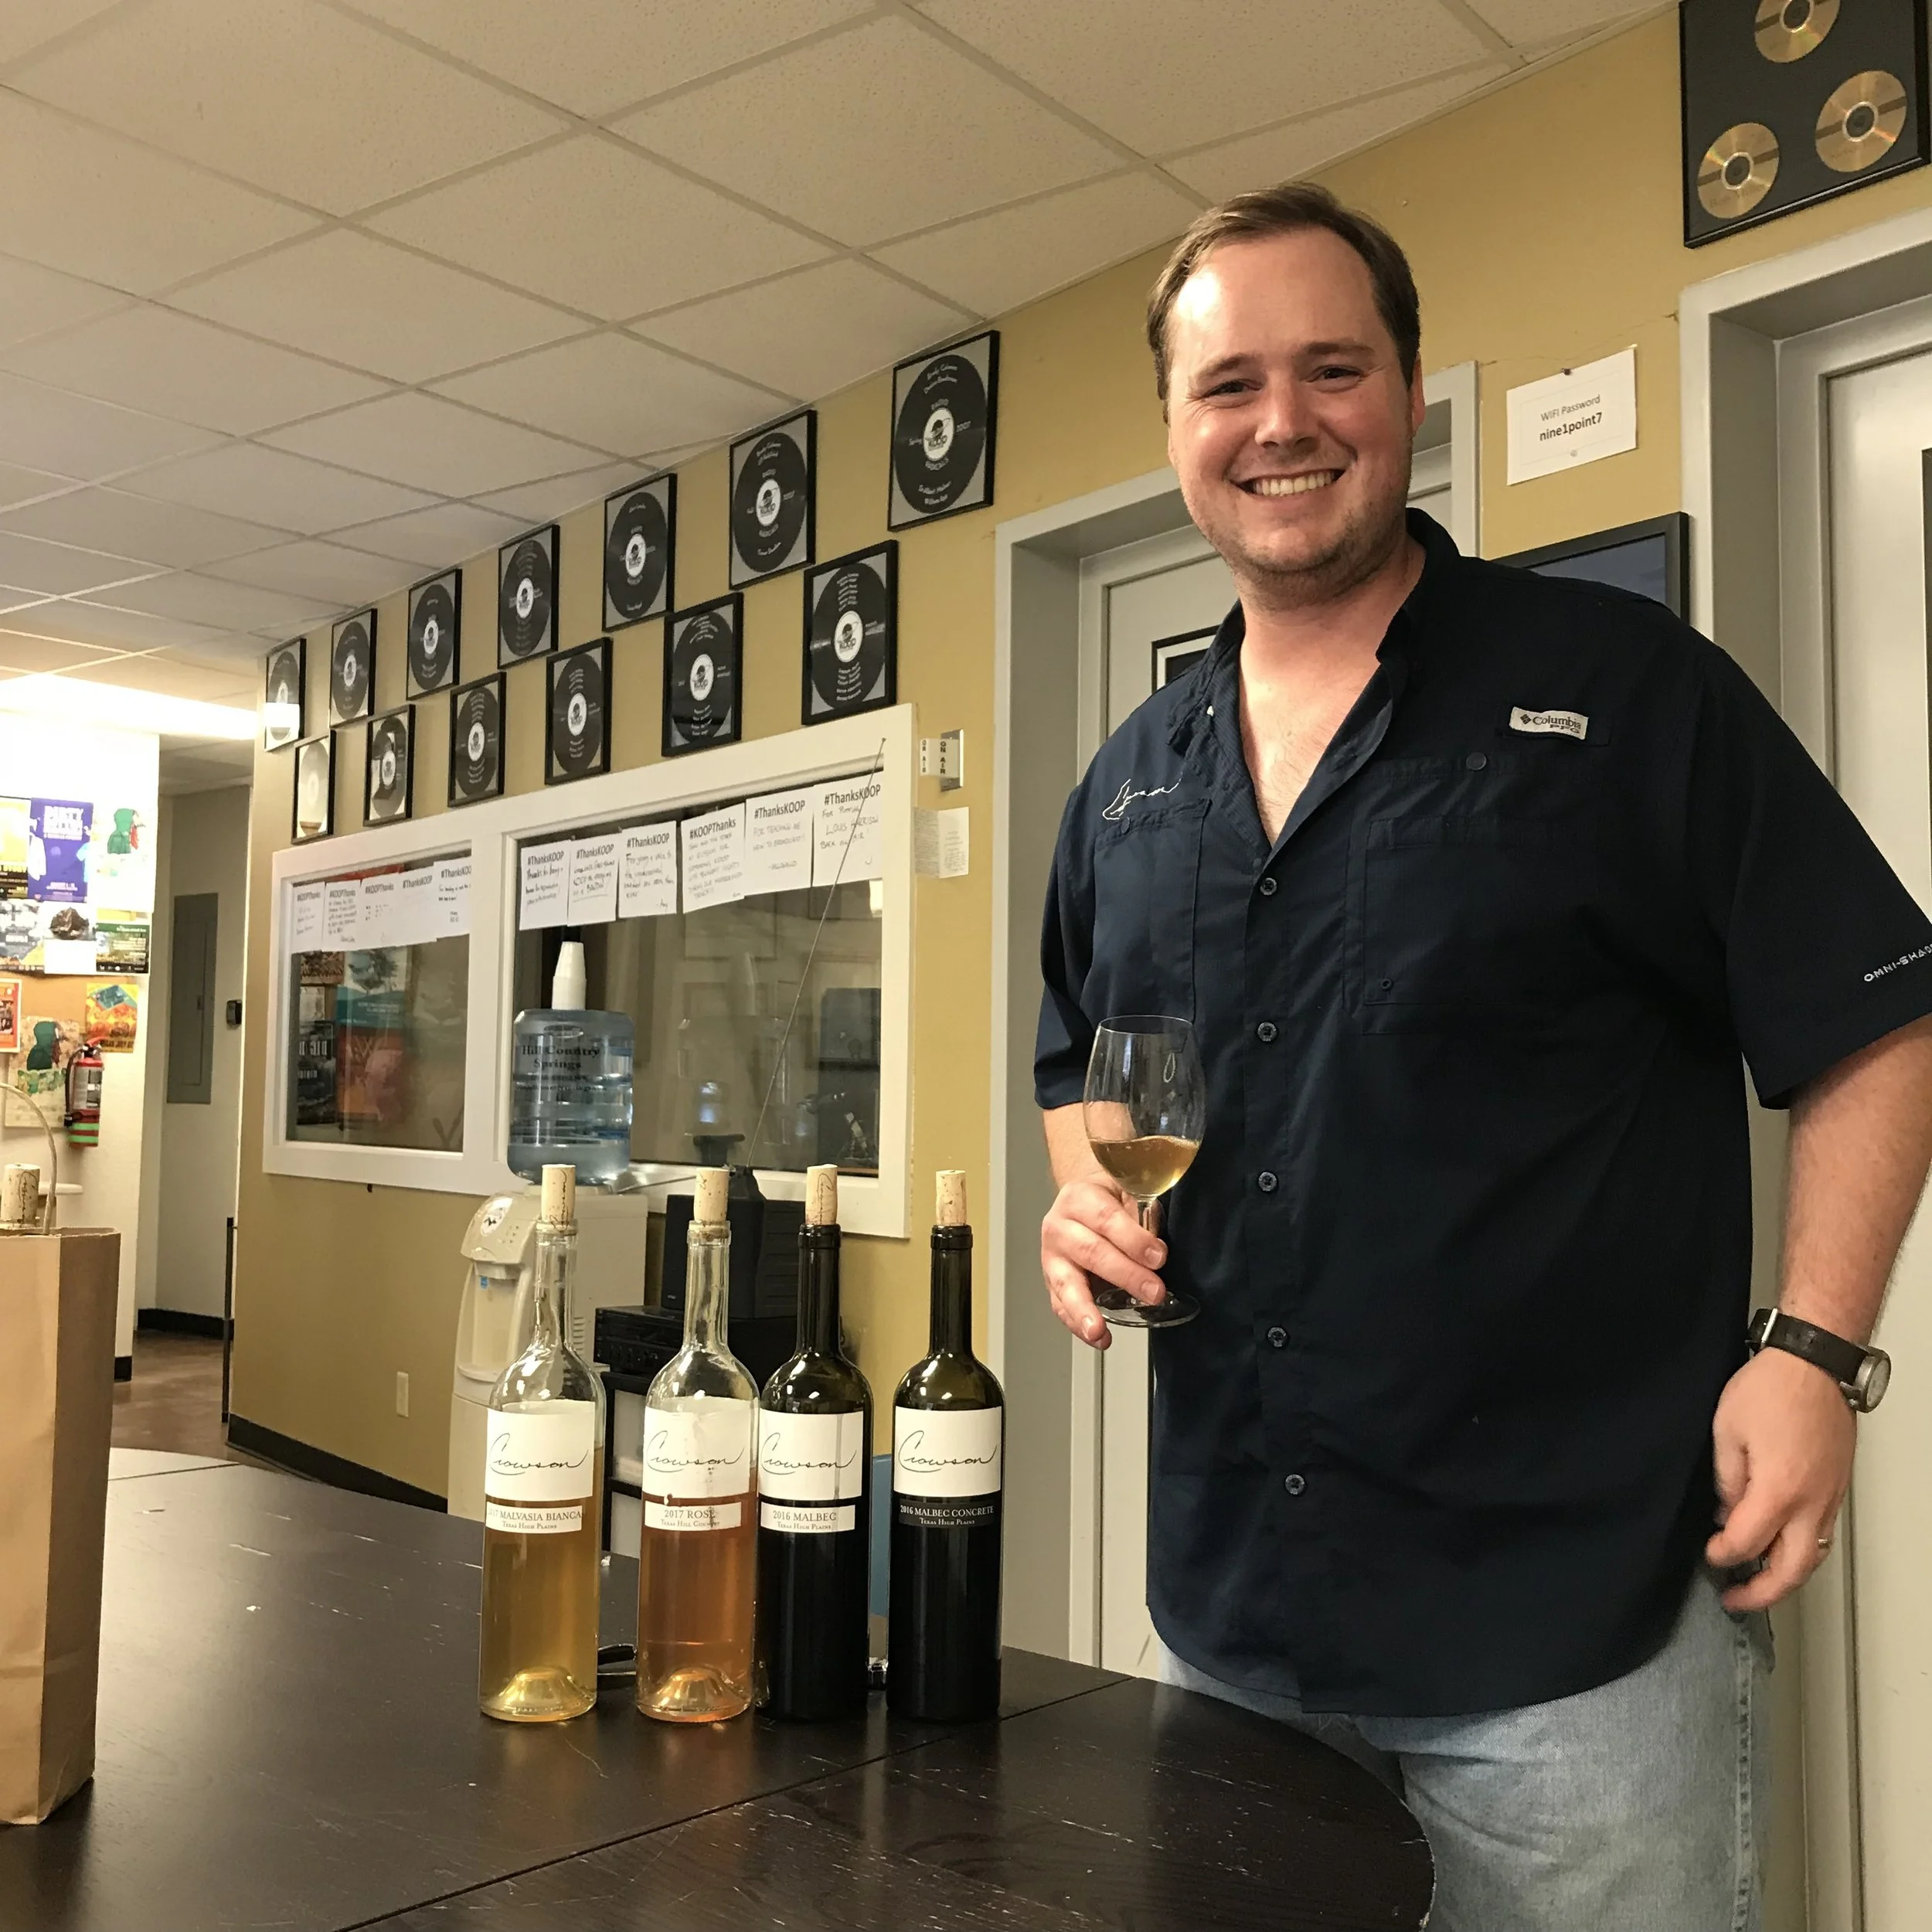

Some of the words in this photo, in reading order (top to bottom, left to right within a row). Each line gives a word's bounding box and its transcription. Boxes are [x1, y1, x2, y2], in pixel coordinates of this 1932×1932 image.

[1561, 394, 1601, 414] Password
[1539, 412, 1603, 441] nine1point7
[1532, 715, 1581, 730] Columbia
[824, 784, 881, 806] #ThanksKOOP
[754, 800, 805, 820] #ThanksKOOP
[689, 818, 736, 840] #KOOPThanks
[627, 833, 670, 849] #ThanksKOOP
[440, 865, 472, 879] #ThanksKOO
[544, 1045, 600, 1058] Country
[533, 1060, 582, 1071] Springs
[489, 1433, 589, 1475] Crowson
[646, 1430, 745, 1473] Crowson
[760, 1432, 857, 1475] Crowson
[899, 1430, 998, 1473] Crowson
[500, 1510, 543, 1522] MALVASIA
[546, 1510, 581, 1522] BIANCA
[664, 1509, 684, 1519] 2017
[773, 1510, 791, 1521] 2016
[793, 1511, 837, 1522] MALBEC
[914, 1507, 950, 1517] MALBEC
[951, 1505, 995, 1517] CONCRETE
